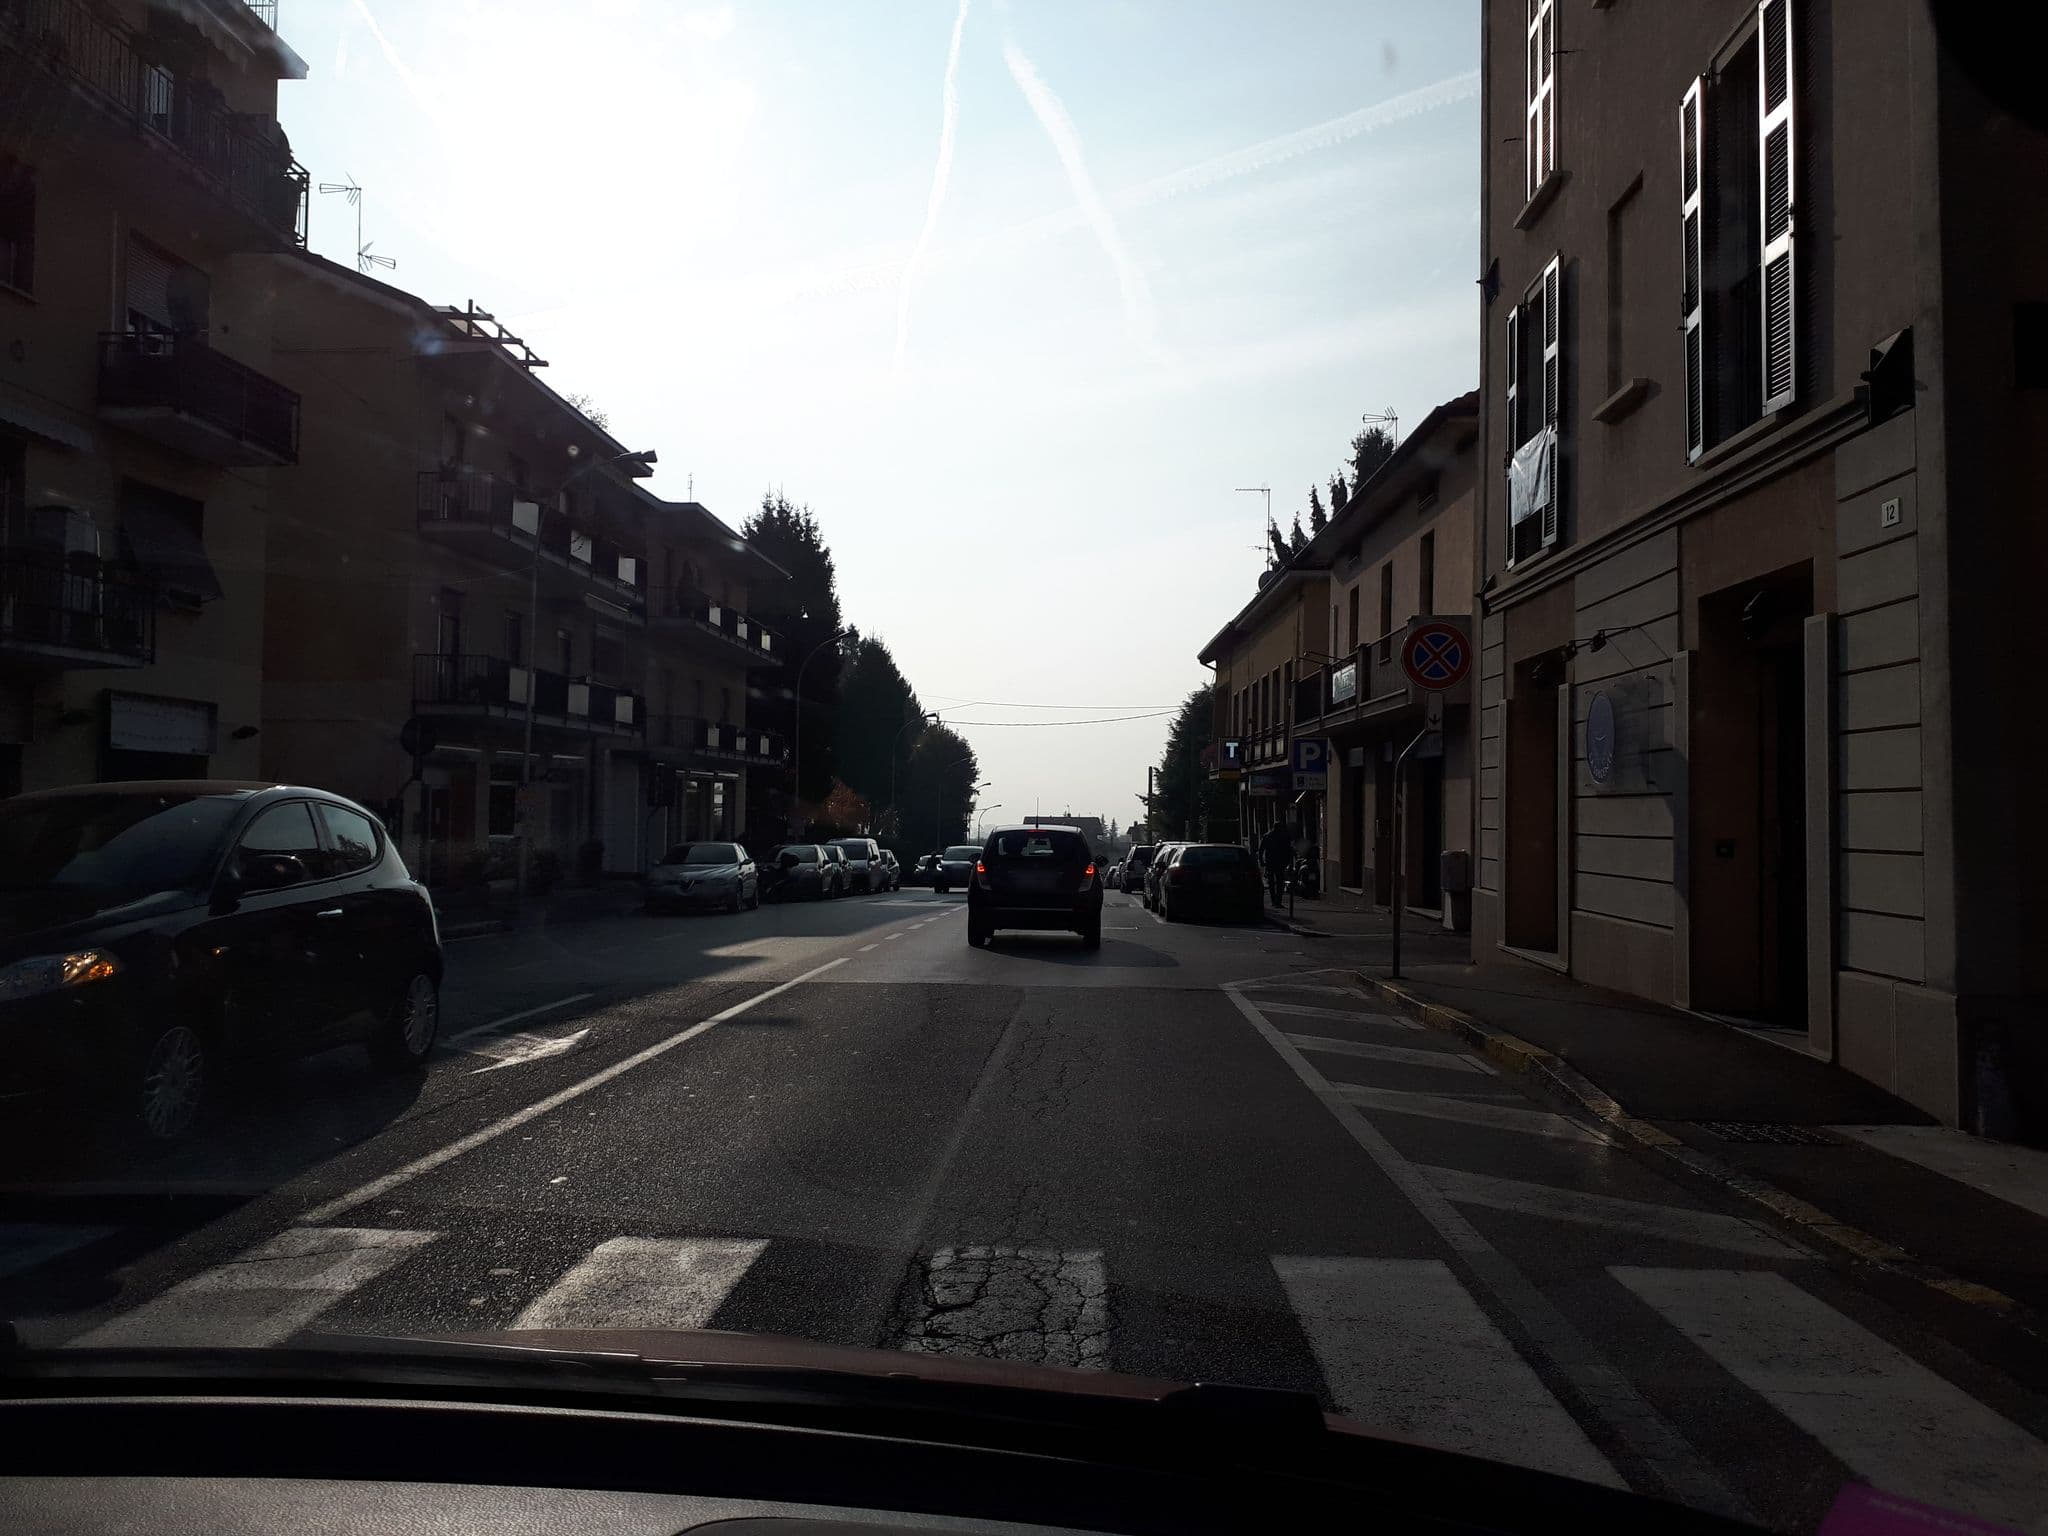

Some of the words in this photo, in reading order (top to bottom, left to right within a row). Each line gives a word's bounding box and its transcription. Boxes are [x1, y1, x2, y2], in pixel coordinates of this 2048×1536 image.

[1886, 504, 1895, 521] 12
[1225, 741, 1239, 758] T
[1299, 742, 1321, 769] P
